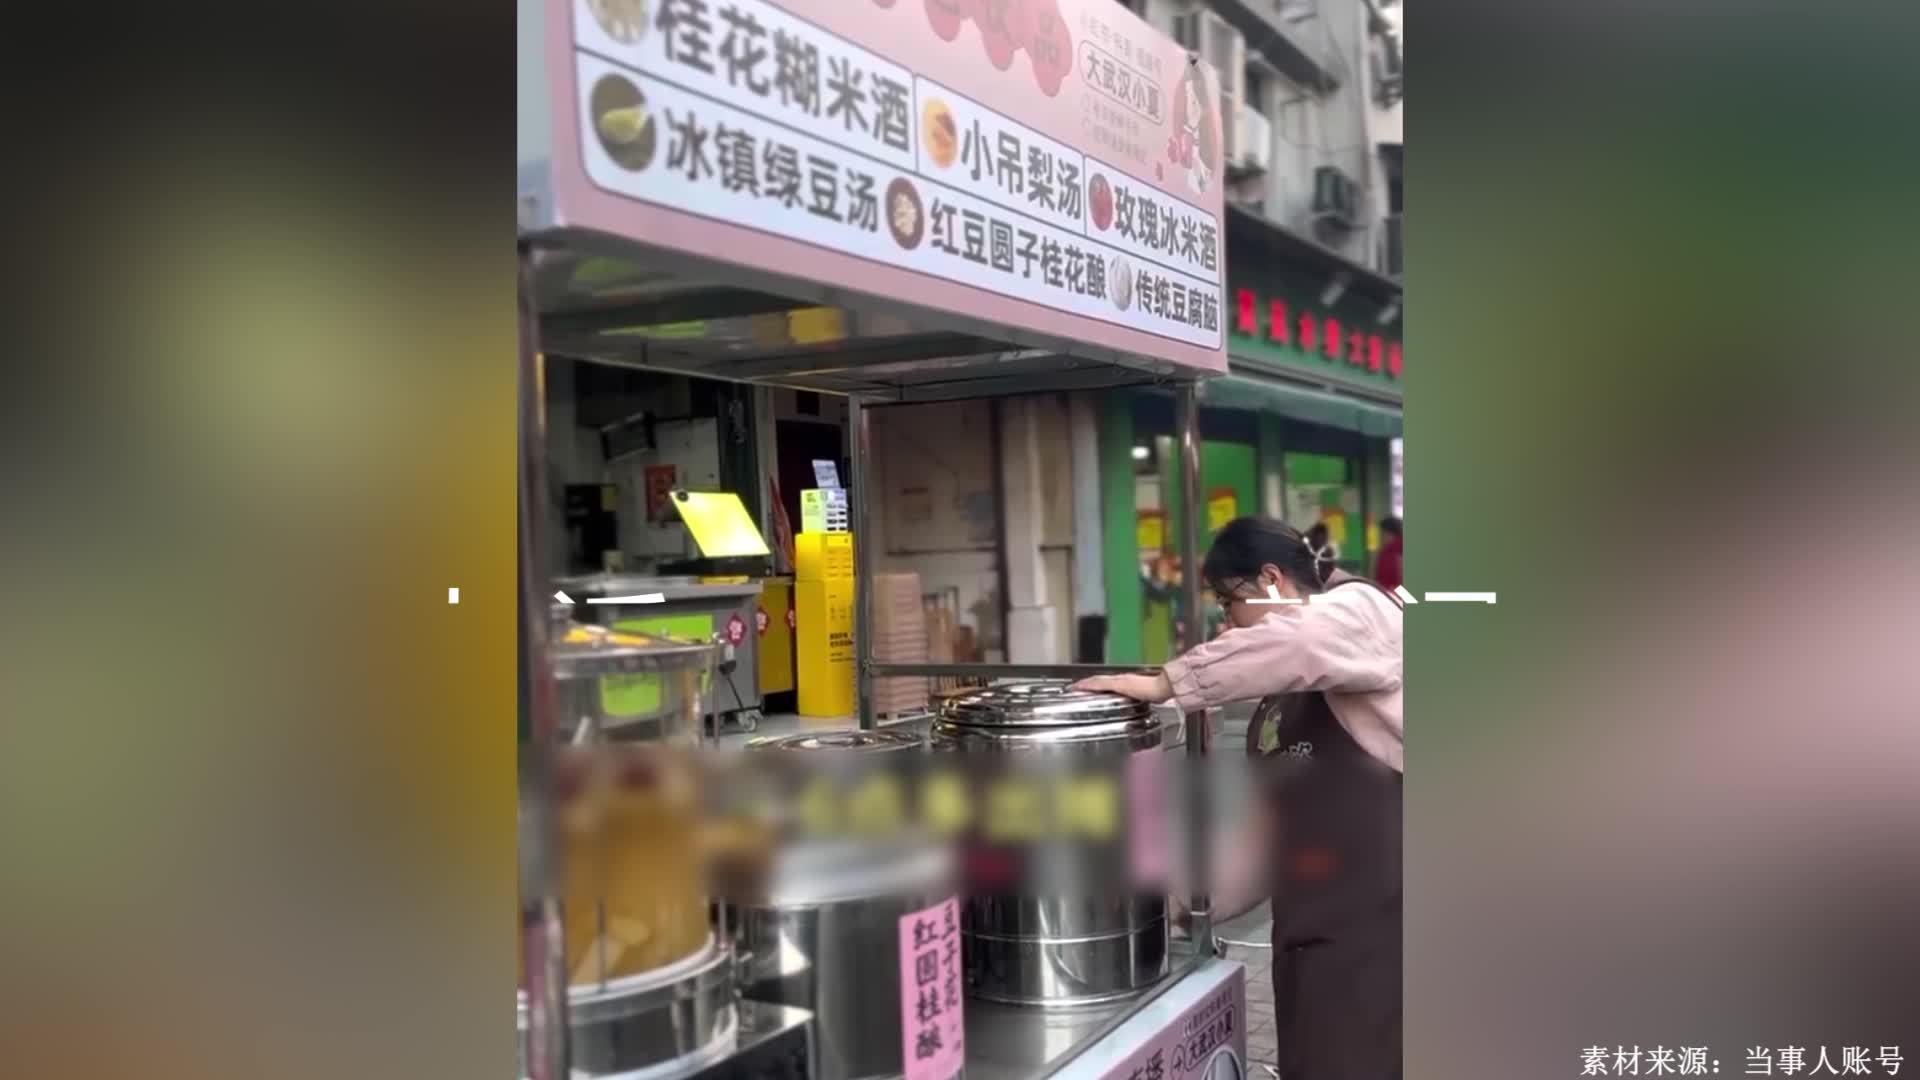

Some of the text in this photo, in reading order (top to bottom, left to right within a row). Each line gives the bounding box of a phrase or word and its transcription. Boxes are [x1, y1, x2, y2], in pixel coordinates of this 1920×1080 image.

[656, 0, 912, 153] 桂花糊米酒
[1087, 50, 1160, 119] 大武汉小夏
[663, 107, 879, 233] 冰镇绿豆汤
[961, 119, 1082, 221] 小吊梨汤
[930, 199, 1107, 300] 红豆圆子桂花酿
[1115, 186, 1218, 273] 玫瑰冰米酒
[1136, 269, 1218, 332] 传统豆腐脑
